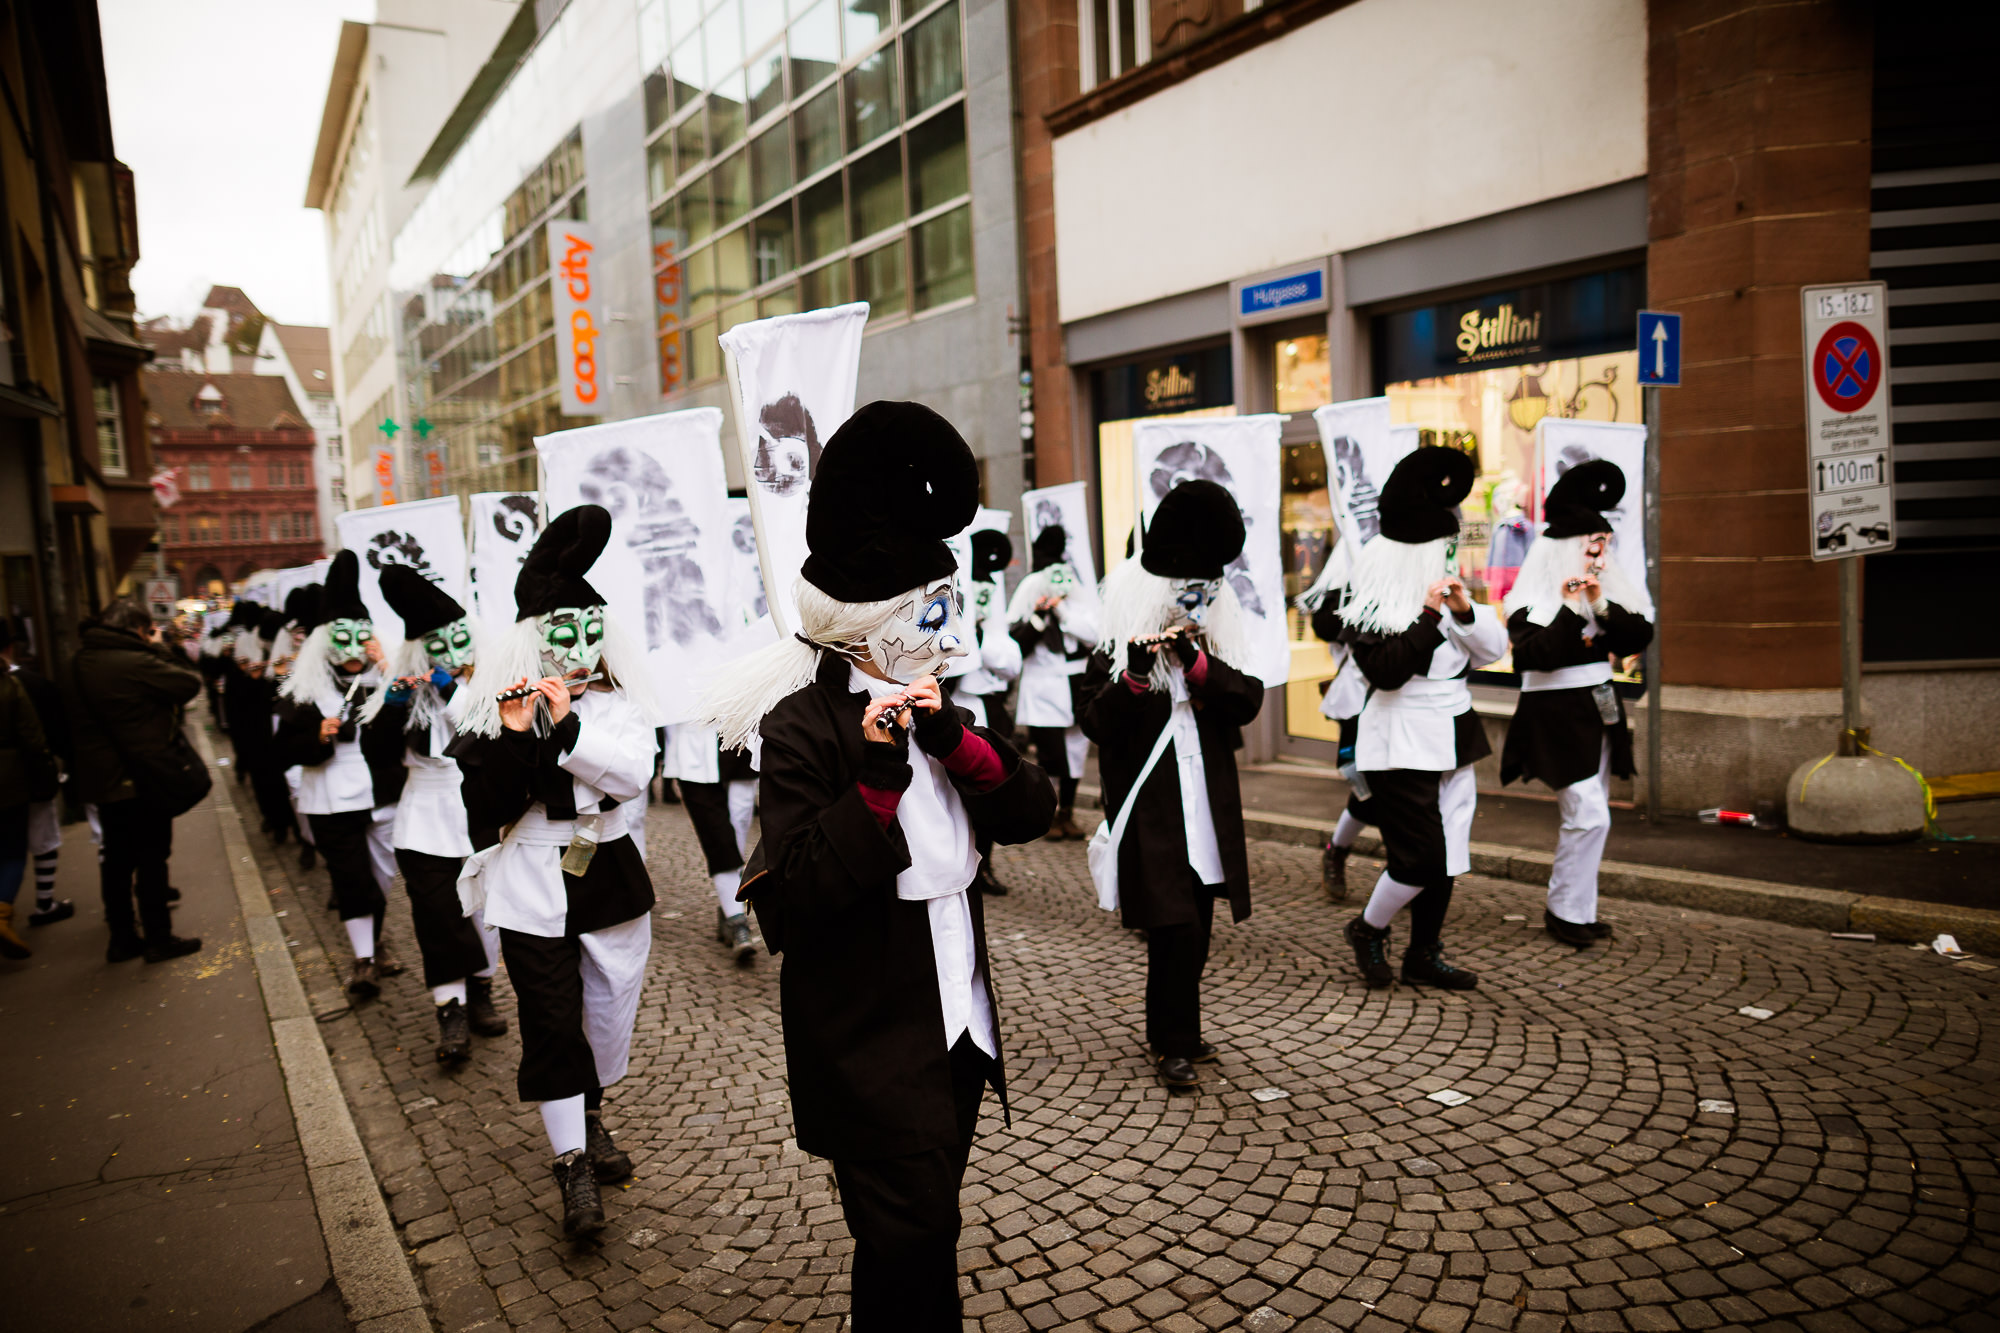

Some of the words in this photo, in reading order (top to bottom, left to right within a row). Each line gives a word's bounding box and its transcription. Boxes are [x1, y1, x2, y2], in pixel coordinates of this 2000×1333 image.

[560, 233, 595, 303] city
[1253, 283, 1308, 308] Hutgasse
[1456, 303, 1541, 357] Stillini
[571, 310, 599, 405] coop
[1144, 365, 1196, 404] Stillini
